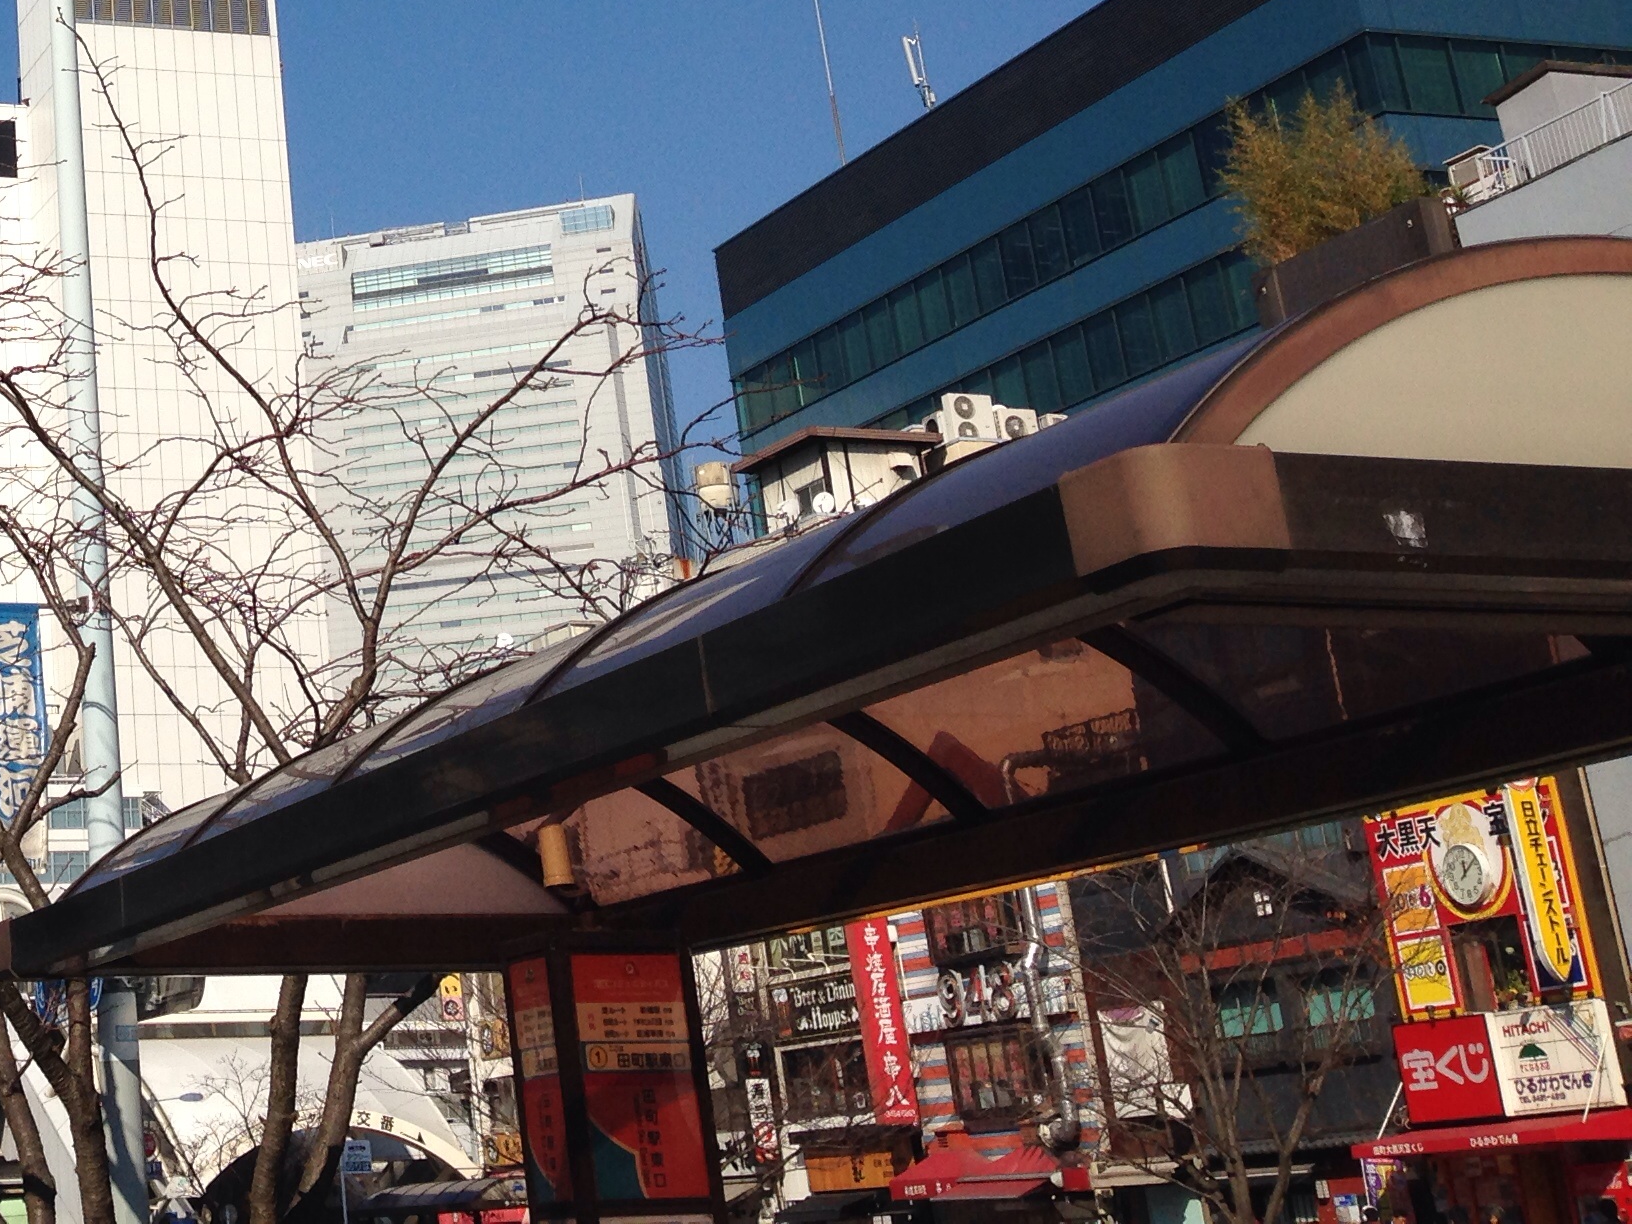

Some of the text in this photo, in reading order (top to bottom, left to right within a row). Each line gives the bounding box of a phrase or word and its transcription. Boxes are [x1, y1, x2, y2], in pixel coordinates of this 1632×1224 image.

[297, 253, 338, 269] NEC
[1376, 816, 1441, 860] 大黒天
[790, 979, 856, 1008] Beer & Dinin
[862, 923, 898, 1046] 串焼居酒屋
[1501, 1021, 1551, 1038] HITACHI
[1402, 1042, 1490, 1092] 宝くじ
[356, 1110, 395, 1132] 交番
